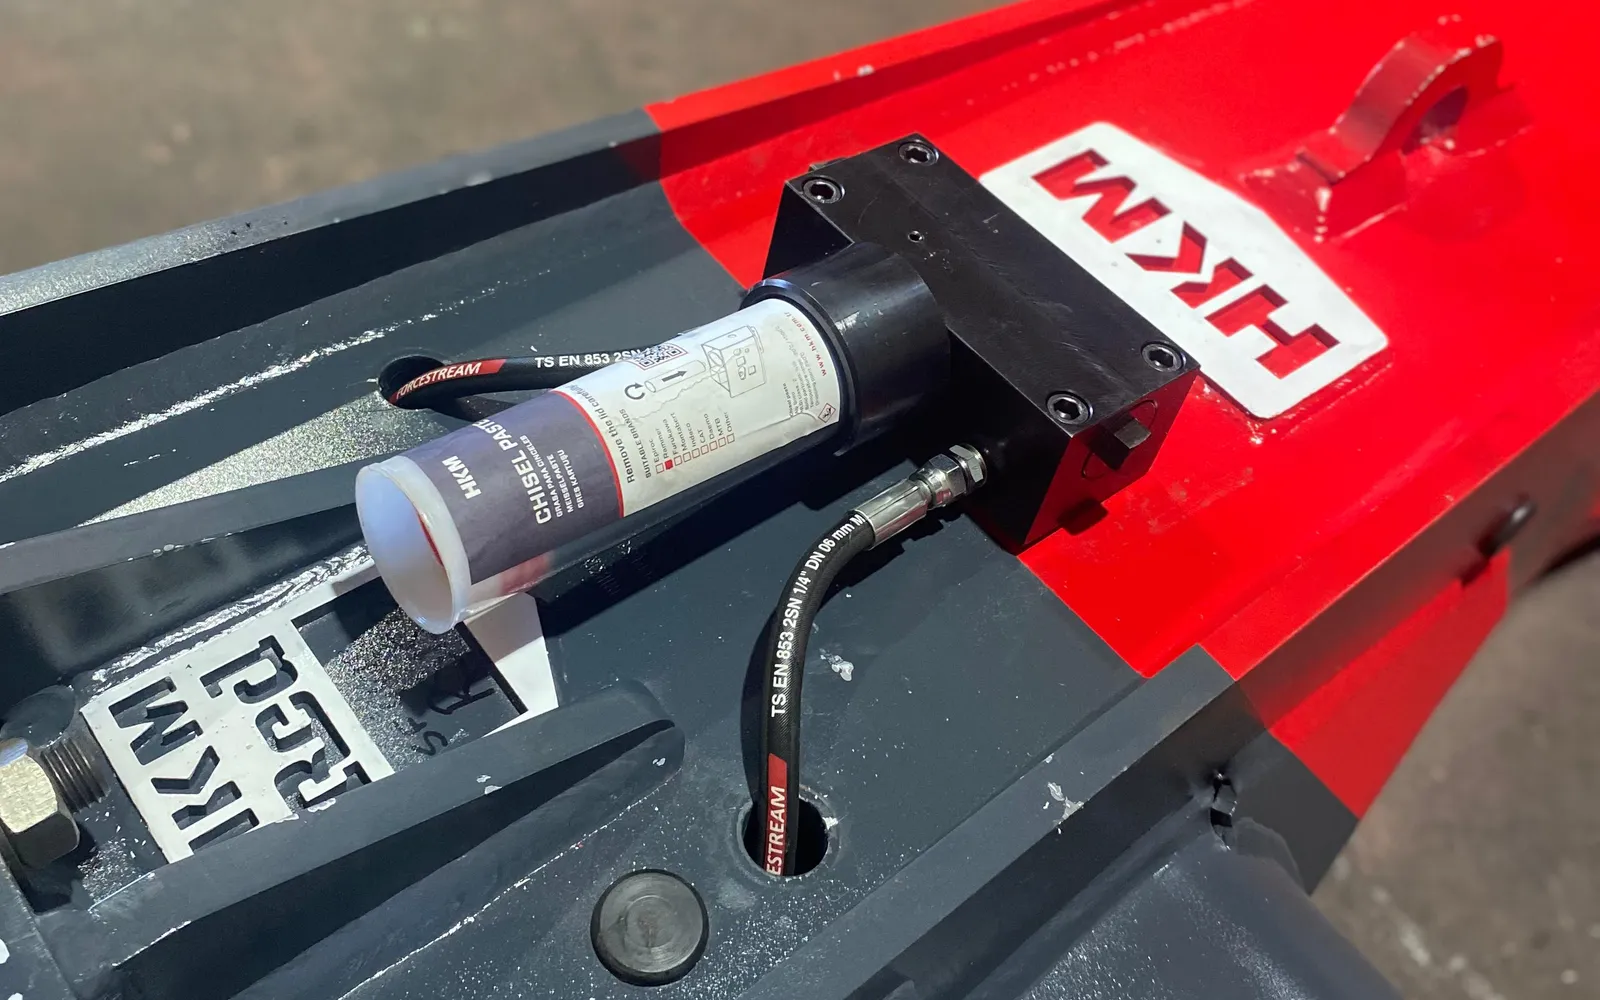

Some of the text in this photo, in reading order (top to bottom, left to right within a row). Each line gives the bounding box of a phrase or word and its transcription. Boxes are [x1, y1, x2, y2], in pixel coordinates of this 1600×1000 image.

[1031, 147, 1341, 380] HKM
[534, 356, 554, 368] TS
[559, 355, 580, 367] EN
[584, 353, 610, 365] 853
[396, 362, 482, 399] FORCESTREAM
[595, 407, 608, 420] lid
[605, 420, 618, 437] the
[616, 438, 635, 484] Remove
[442, 455, 482, 500] HKM
[511, 449, 552, 524] CHISEL
[818, 537, 836, 553] 06
[832, 522, 855, 541] mm
[804, 550, 826, 571] DN
[783, 597, 803, 628] 2SN
[776, 631, 795, 660] 853
[773, 663, 789, 688] EN
[771, 691, 787, 718] TS
